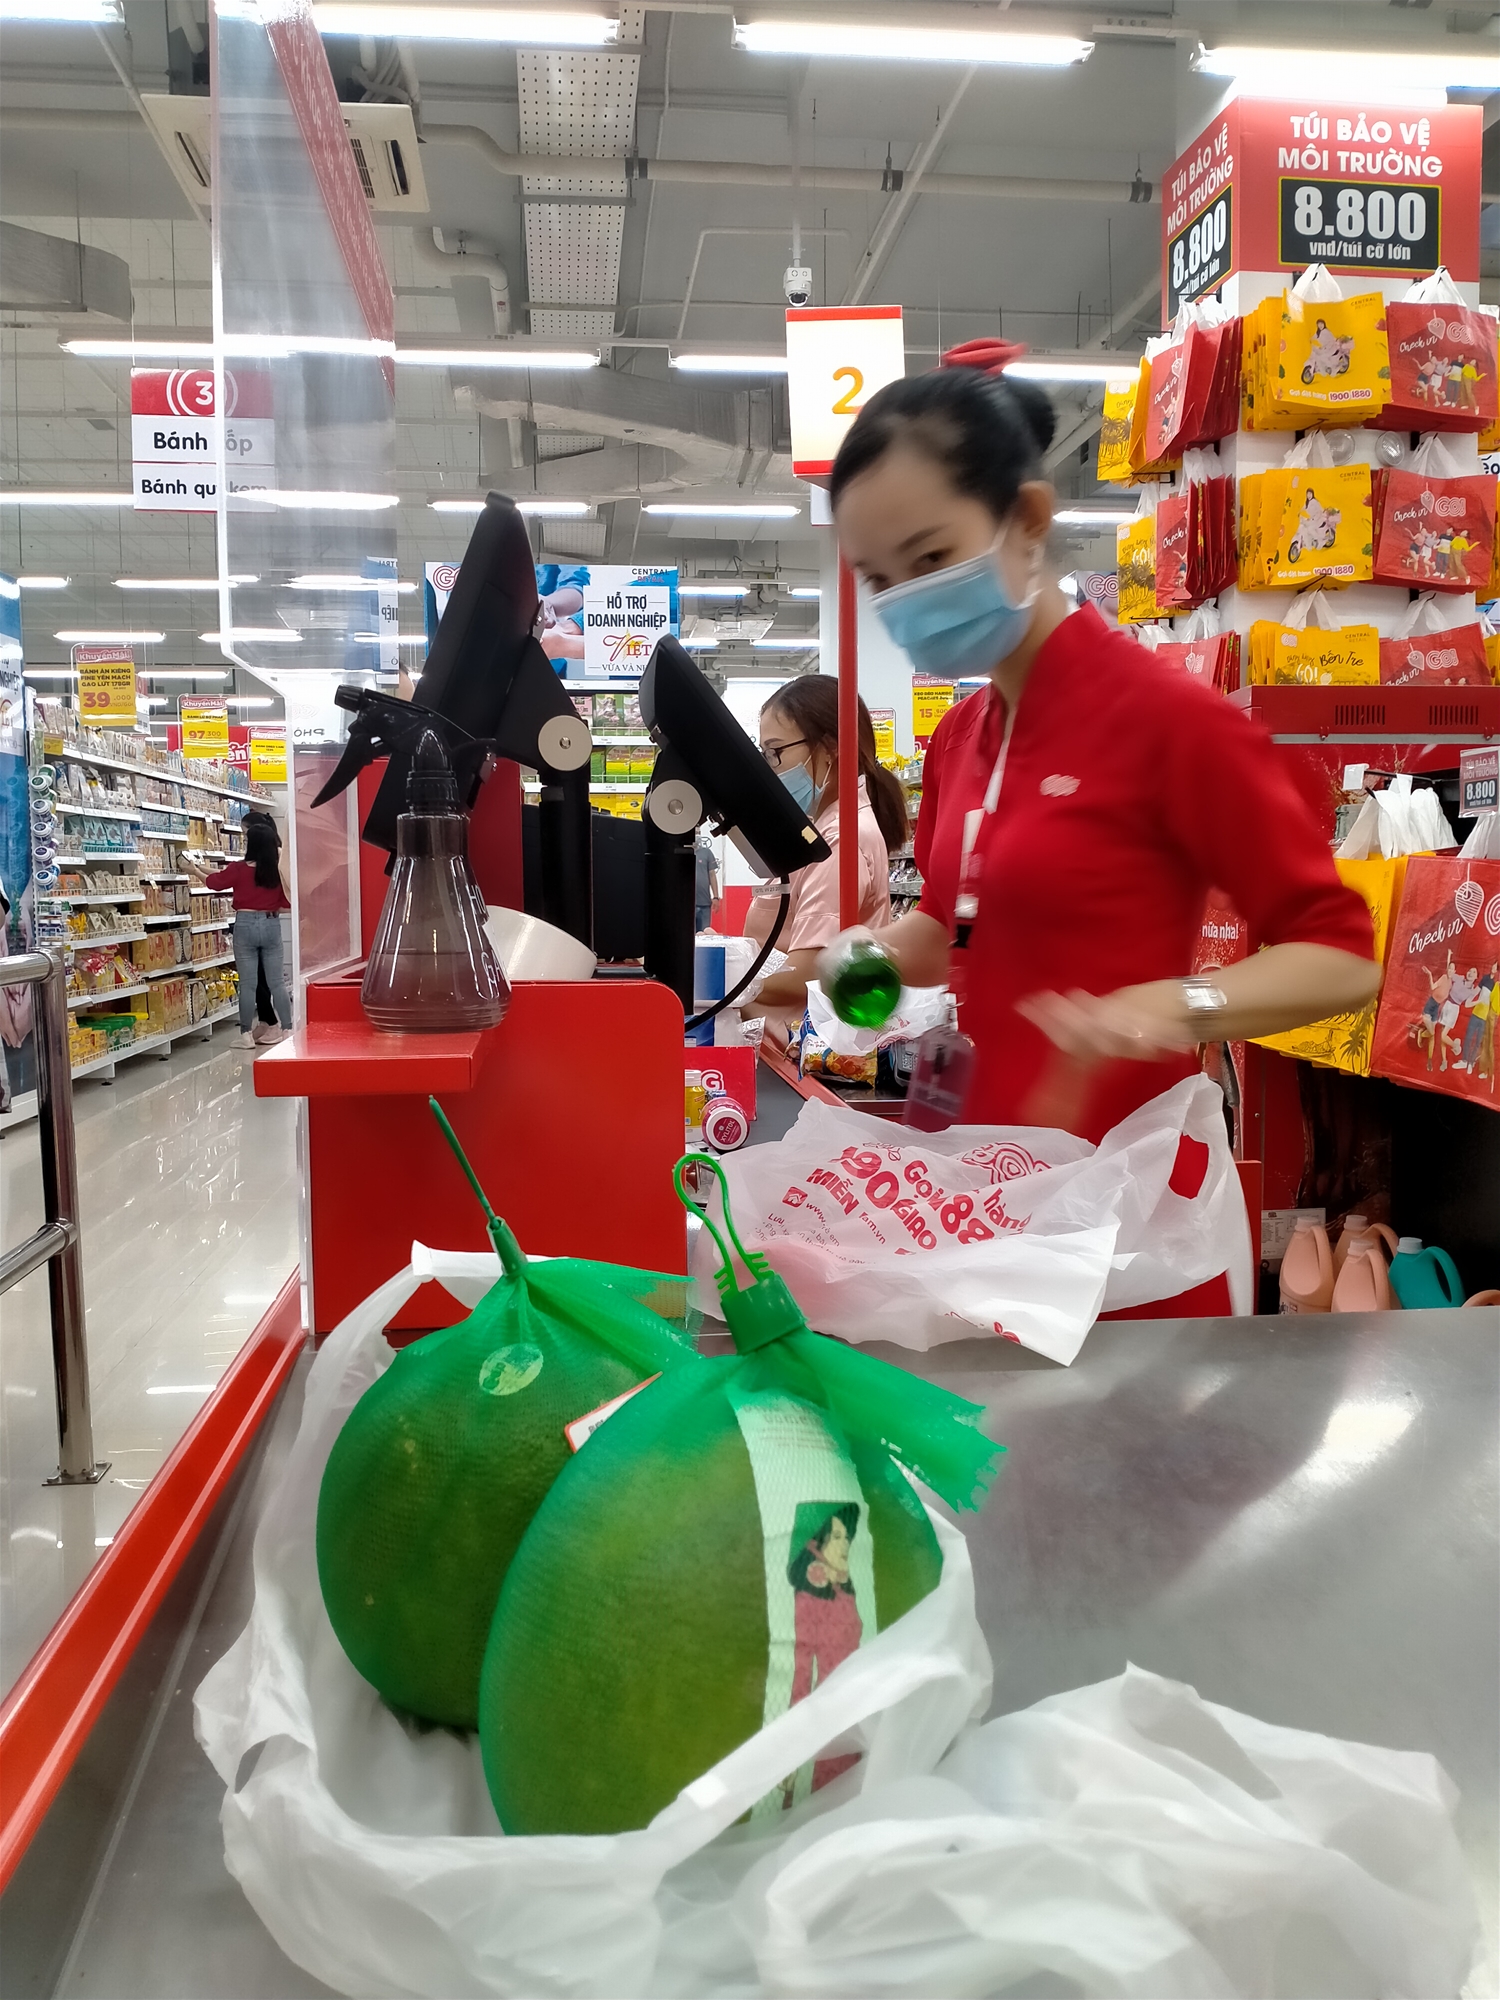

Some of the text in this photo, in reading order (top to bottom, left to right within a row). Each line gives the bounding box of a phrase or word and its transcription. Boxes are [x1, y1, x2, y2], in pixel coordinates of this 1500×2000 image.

[1290, 111, 1430, 151] TÚI BẢO VỆ
[1172, 122, 1228, 202] TÚI BẢO VỆ
[1278, 143, 1443, 177] MÔI TRƯỜNG
[1167, 155, 1233, 236] MÔI TRƯỜNG
[1294, 186, 1426, 241] 8.800
[1173, 200, 1226, 289] 8.800
[1309, 239, 1411, 260] vnd/túi cỡ lớn
[1351, 297, 1377, 306] CENTRAL
[1400, 334, 1439, 353] Check in
[195, 381, 214, 406] 3
[832, 366, 865, 415] 2
[1329, 391, 1350, 400] 1900
[1351, 389, 1371, 399] 1880
[153, 428, 253, 457] Bánh ốp
[141, 479, 187, 495] Bánh
[194, 483, 217, 499] qu
[1394, 507, 1429, 522] Check in
[1435, 496, 1467, 517] GO!
[632, 568, 669, 576] CENTRAL
[1335, 565, 1354, 575] 1880
[1085, 574, 1119, 598] GO
[606, 592, 647, 612] HỖ TRỢ
[587, 612, 667, 631] DOANH NGHIỆP
[603, 634, 652, 662] VIỆT
[1319, 650, 1344, 667] Bến
[1345, 651, 1365, 667] Tre
[602, 663, 620, 672] VỪA
[621, 663, 635, 672] VÀ
[1426, 648, 1459, 670] GO!
[83, 691, 111, 709] 39
[919, 708, 933, 719] 15
[188, 731, 205, 740] 97
[1466, 780, 1496, 800] 8.800
[1202, 921, 1219, 938] nữa
[1408, 917, 1464, 954] Check in
[720, 1119, 736, 1143] XYLITOL
[806, 1168, 860, 1216] MIỄN
[890, 1198, 938, 1250] GIAO
